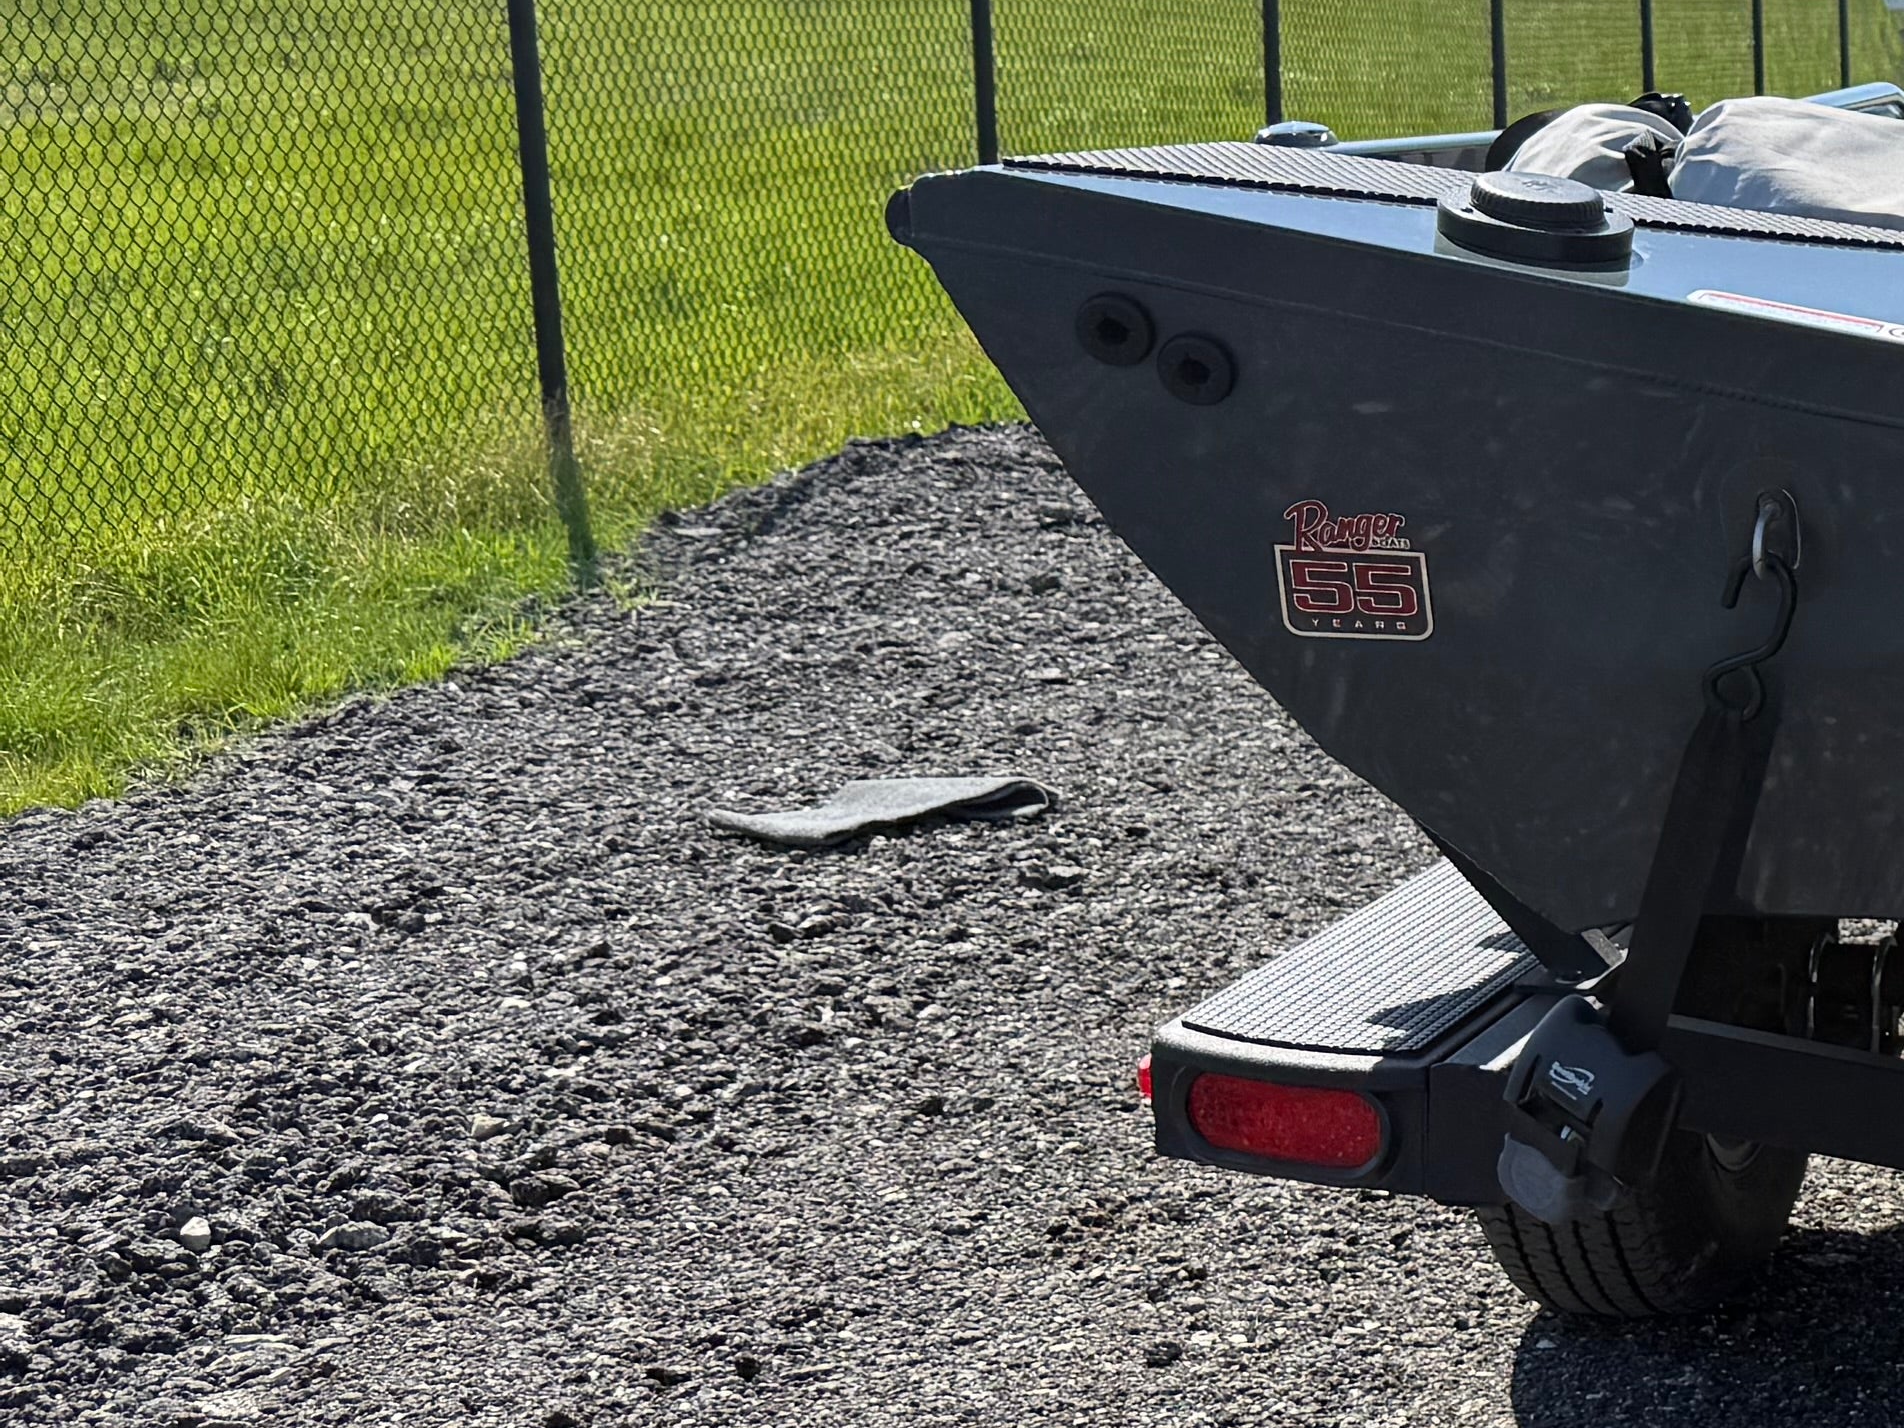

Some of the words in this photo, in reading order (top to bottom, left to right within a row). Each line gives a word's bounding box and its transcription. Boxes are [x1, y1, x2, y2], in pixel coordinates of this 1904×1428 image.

[1283, 499, 1406, 552] Ranger
[1289, 559, 1418, 617] 55
[1312, 618, 1407, 631] YEARS
